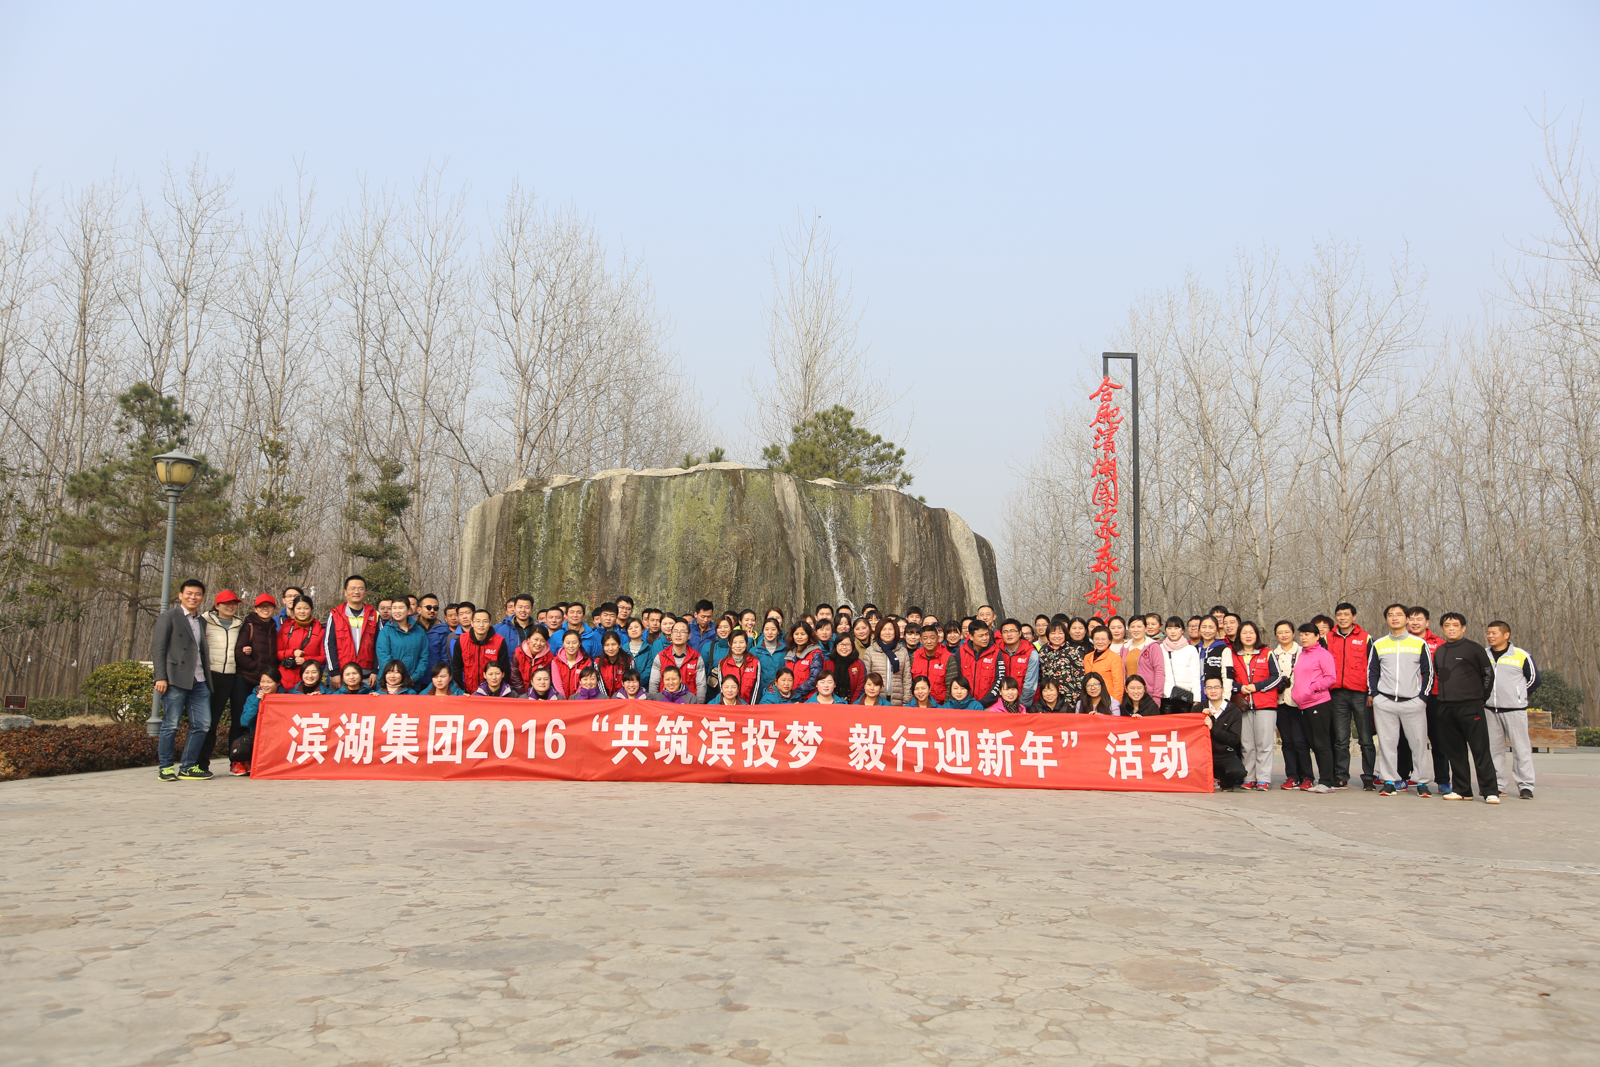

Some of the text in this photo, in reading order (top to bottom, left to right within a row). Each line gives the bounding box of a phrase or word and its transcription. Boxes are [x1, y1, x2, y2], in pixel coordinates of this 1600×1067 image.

[1500, 658, 1520, 666] WEAR
[286, 712, 567, 765] 滨湖集团2016
[1104, 730, 1189, 780] 活动
